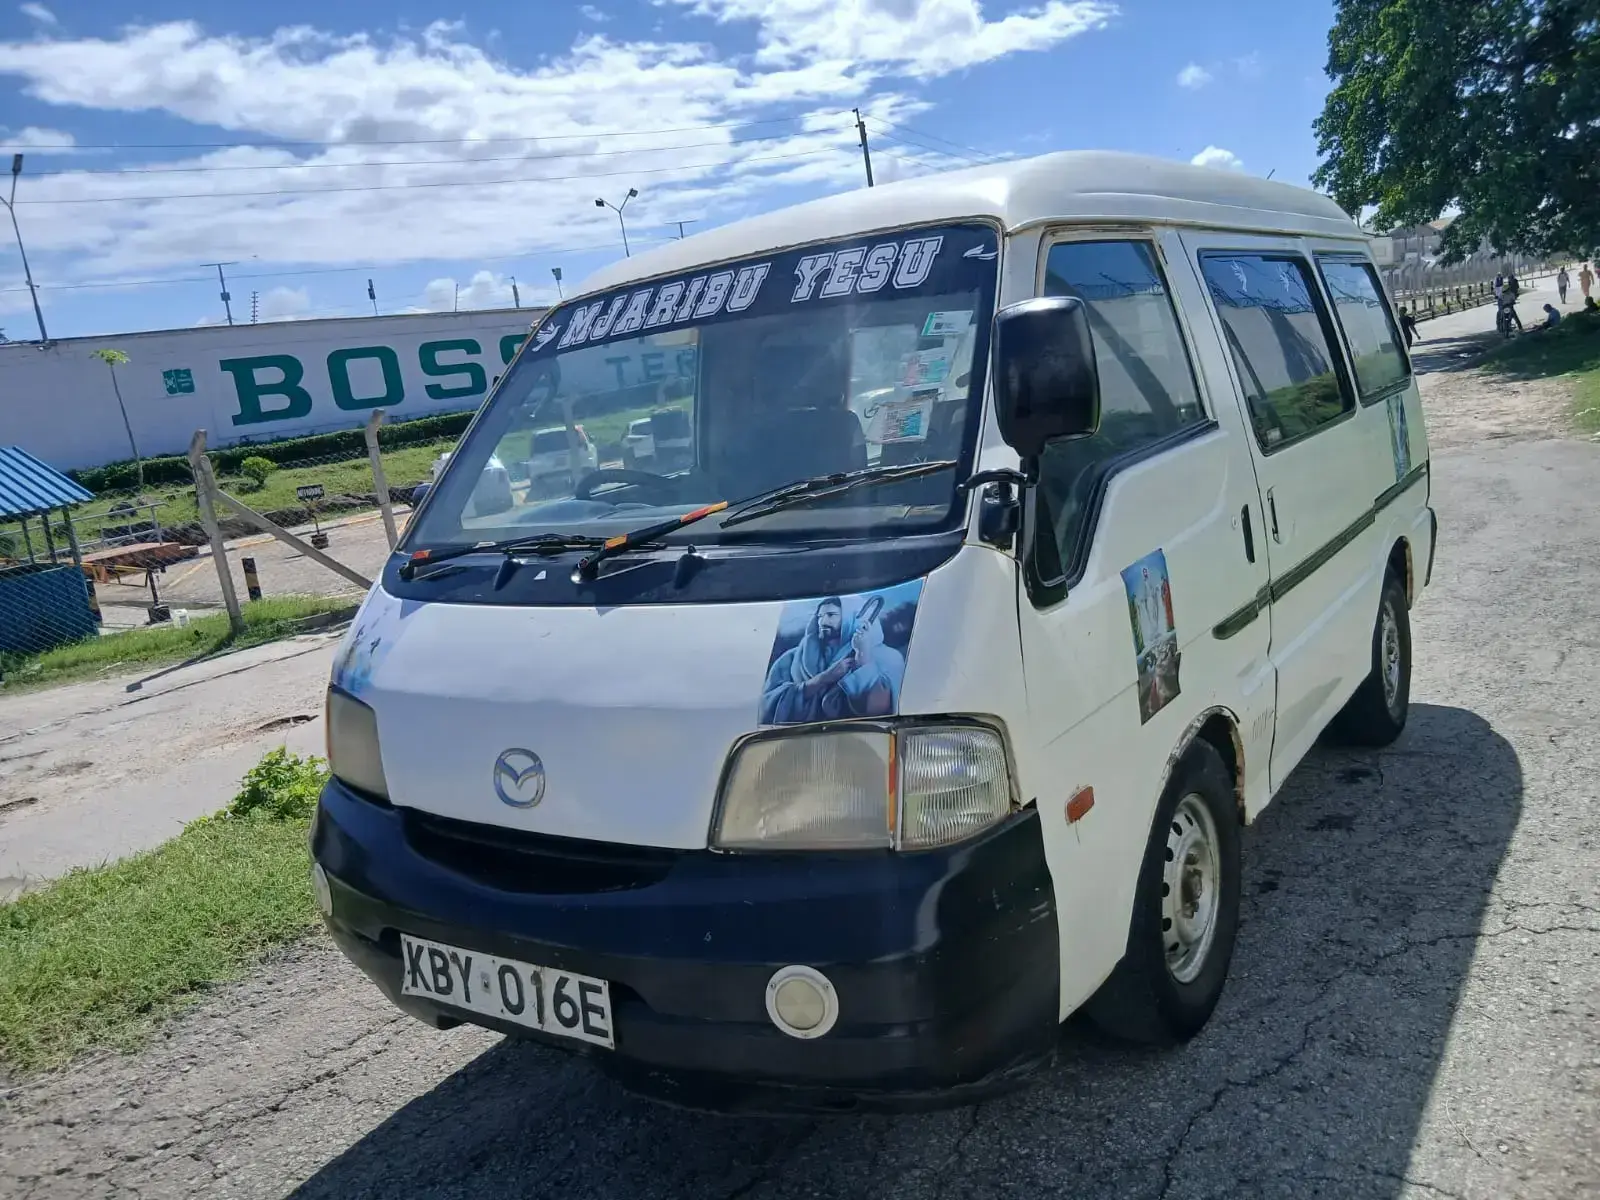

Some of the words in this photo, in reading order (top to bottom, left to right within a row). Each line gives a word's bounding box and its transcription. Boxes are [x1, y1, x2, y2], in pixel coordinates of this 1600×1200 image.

[557, 263, 771, 349] MJARIBU
[791, 236, 943, 302] YESU
[406, 941, 473, 1003] KBY
[498, 964, 608, 1038] 016E
